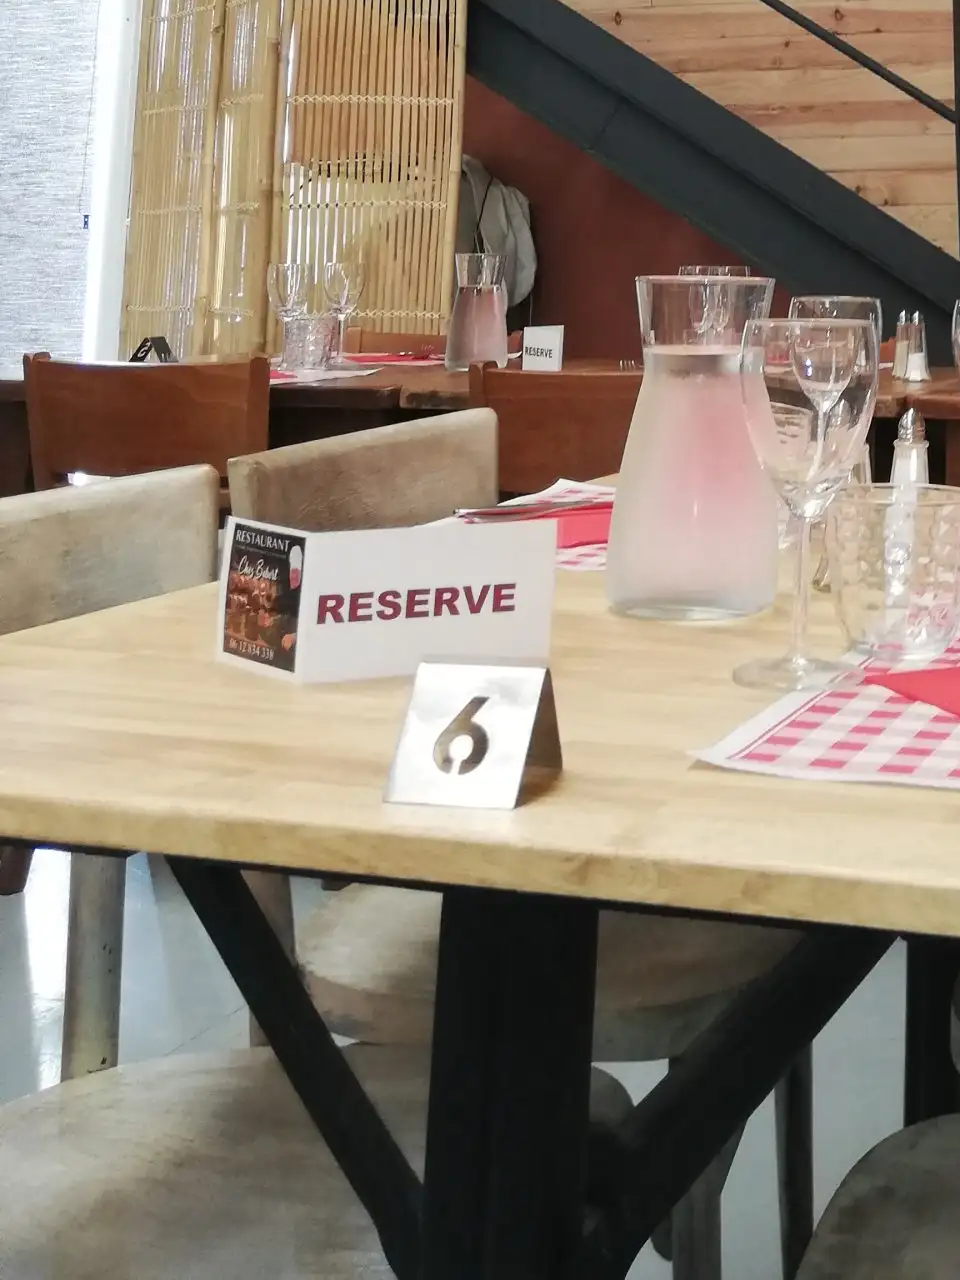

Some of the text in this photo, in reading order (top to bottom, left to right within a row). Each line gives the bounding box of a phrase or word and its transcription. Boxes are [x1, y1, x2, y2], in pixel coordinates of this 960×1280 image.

[524, 346, 553, 359] RESERVE
[235, 529, 290, 553] RESTAURANT
[316, 583, 517, 625] RESERVE
[432, 695, 490, 776] 6
